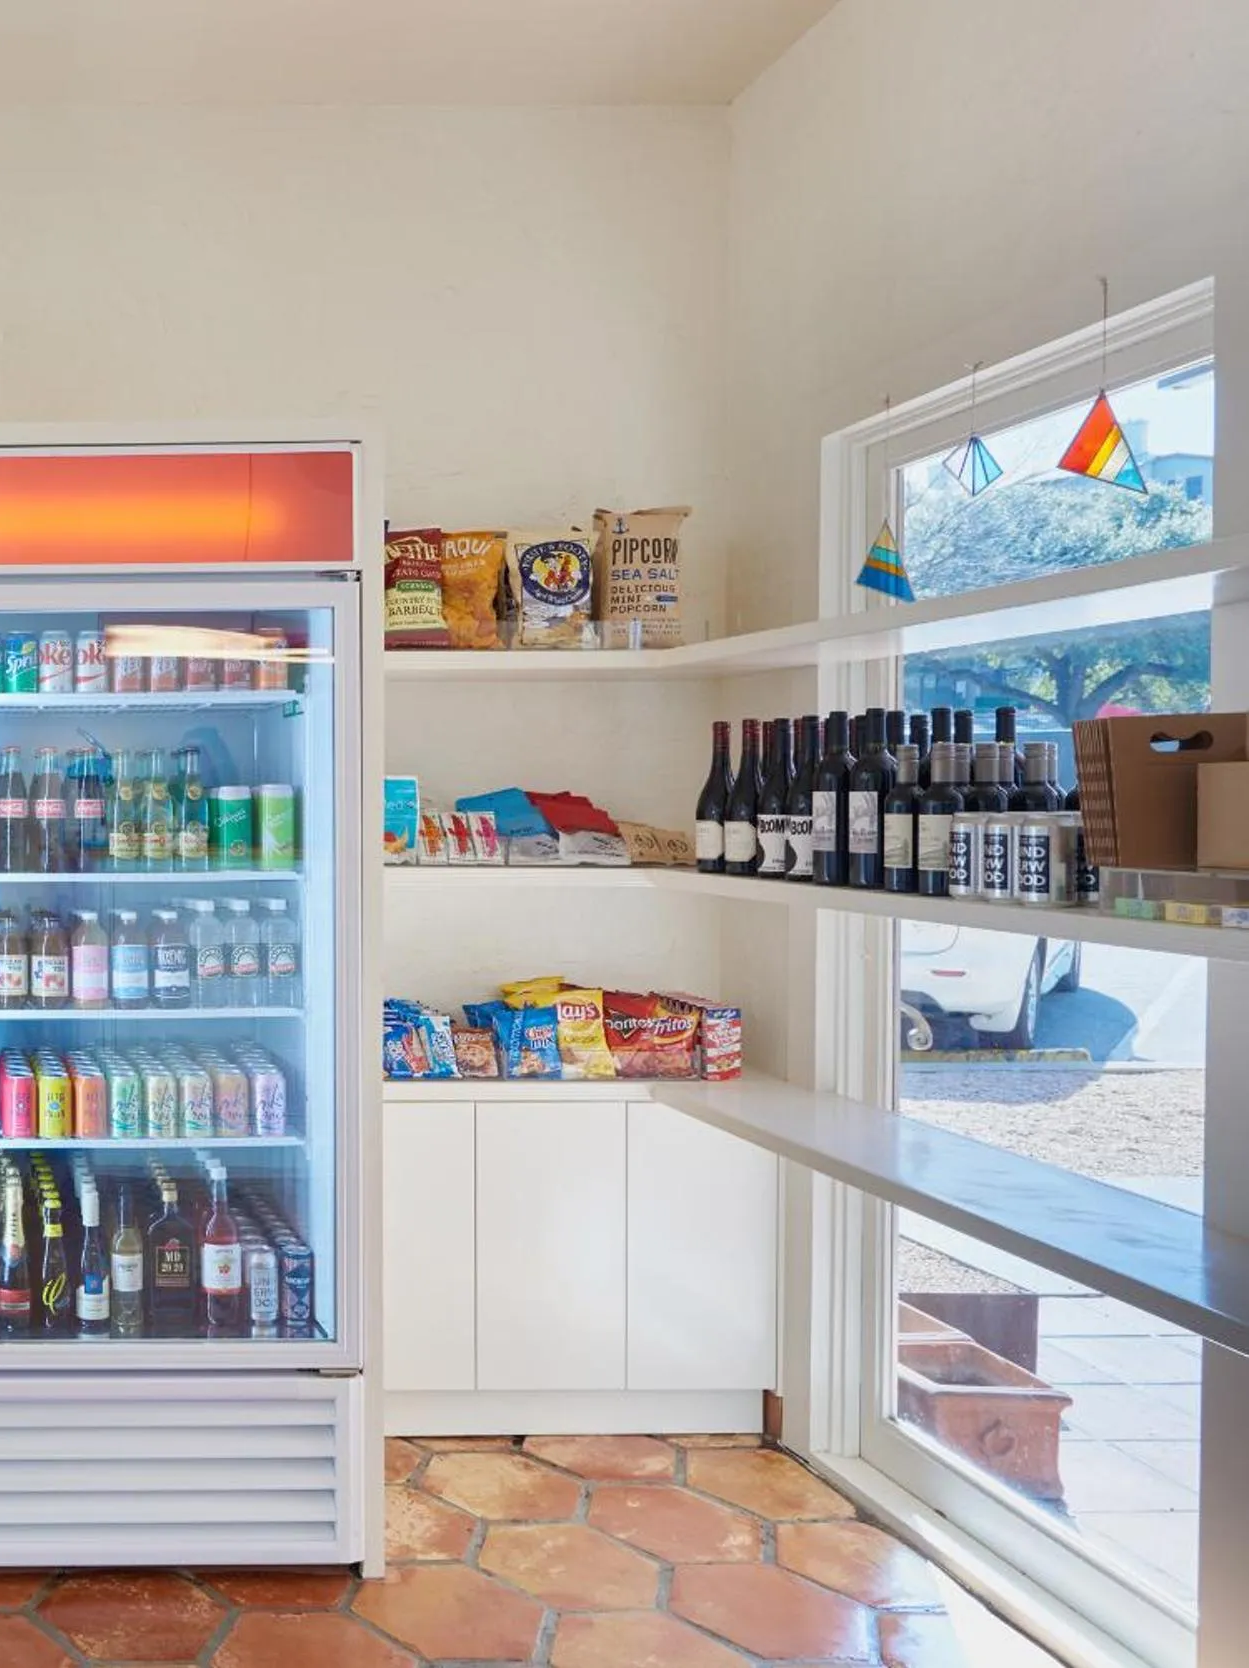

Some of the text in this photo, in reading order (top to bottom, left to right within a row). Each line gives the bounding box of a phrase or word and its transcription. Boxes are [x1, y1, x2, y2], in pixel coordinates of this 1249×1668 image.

[441, 537, 492, 560] AQUI
[611, 568, 642, 581] SEA
[611, 584, 676, 595] DELICIOUS
[610, 604, 667, 615] POPCORN
[39, 642, 71, 665] oke
[5, 652, 36, 674] Spri
